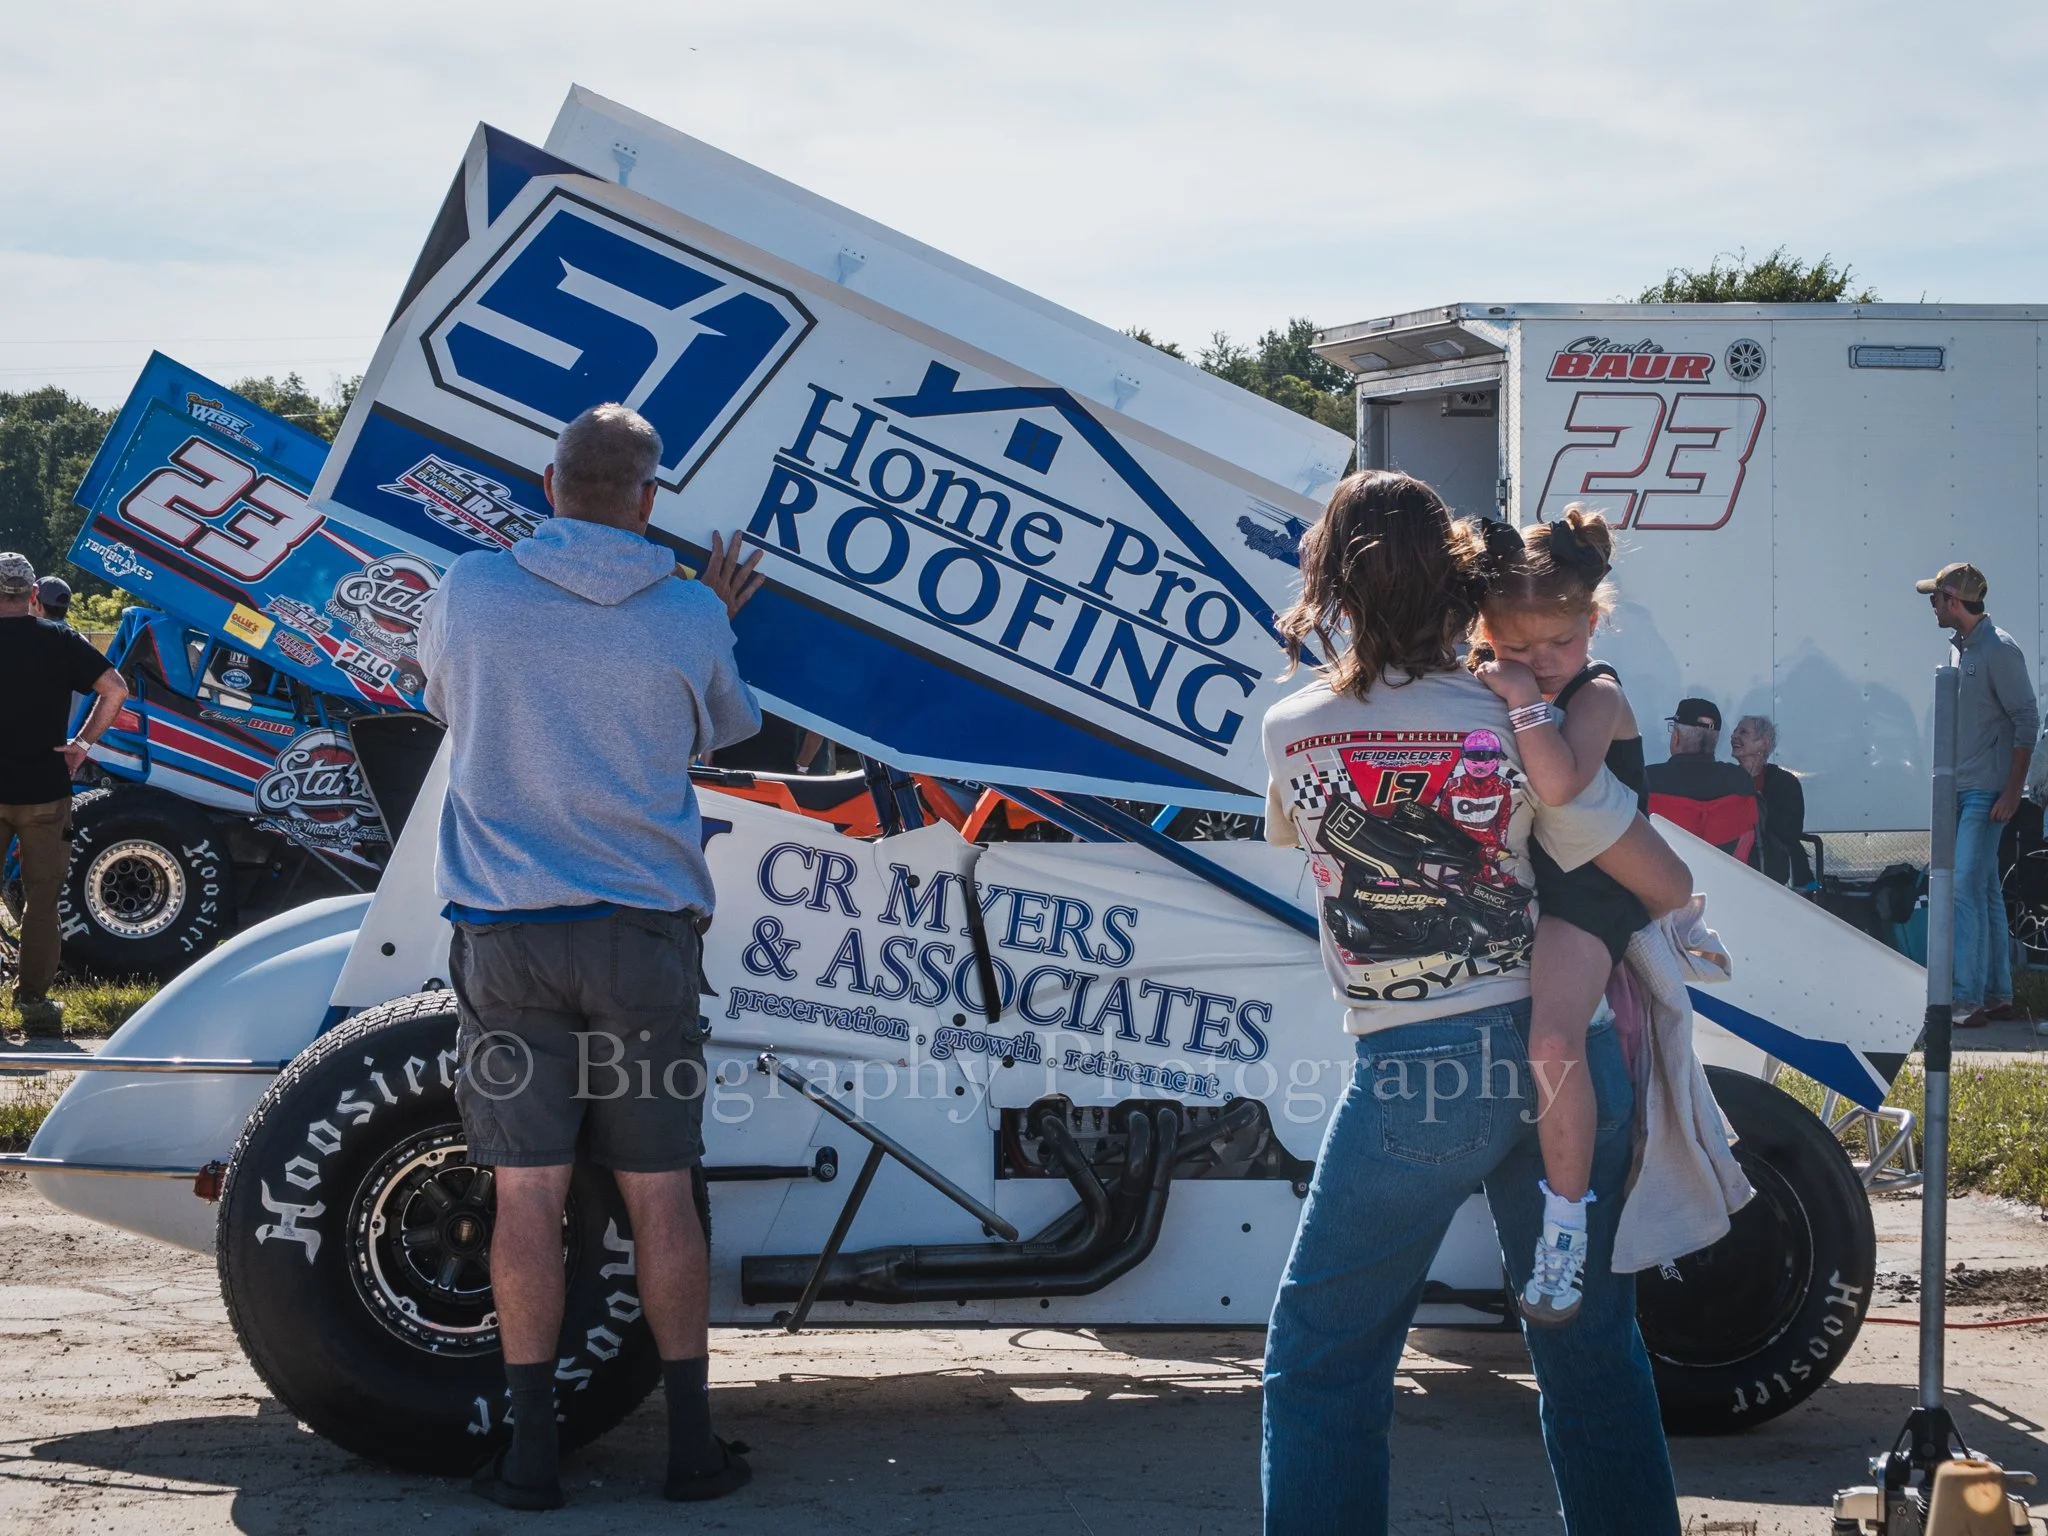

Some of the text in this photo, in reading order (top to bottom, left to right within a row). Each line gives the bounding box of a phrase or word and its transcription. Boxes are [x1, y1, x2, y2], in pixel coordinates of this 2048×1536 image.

[445, 208, 792, 471] 51
[1564, 336, 1665, 354] Charlie
[1546, 351, 1716, 384] BAUR
[190, 402, 249, 433] WISE
[1536, 391, 1767, 531] 23
[415, 471, 462, 503] BUMPER
[425, 464, 472, 495] BUMPER
[117, 434, 327, 584] 23
[417, 485, 505, 543] OUTLAW SPRINT SERIES
[462, 494, 509, 525] IRA
[779, 382, 1241, 647] Home Pro
[511, 521, 533, 537] Auto
[106, 549, 154, 581] BRAKES
[340, 563, 438, 630] Stah
[746, 464, 1257, 746] ROOFING
[231, 613, 259, 632] OLLIE'S
[325, 600, 361, 625] Motors
[366, 622, 395, 645] Music
[393, 637, 420, 661] Exper
[275, 637, 313, 667] BATTERIES
[278, 630, 321, 664] INTERSTATE
[346, 665, 374, 682] RACING
[353, 650, 393, 679] FLO
[200, 709, 247, 725] Charlie
[247, 718, 295, 737] BAUR
[1293, 732, 1459, 753] WRENCHIN TO WHEELIN
[1350, 750, 1452, 762] HEIDBREDER
[260, 750, 376, 818] Stah
[1373, 769, 1432, 807] 19
[303, 821, 338, 837] Music
[1325, 801, 1366, 841] 19
[181, 840, 220, 951] Hoosier
[757, 841, 861, 918] CR
[877, 862, 1138, 968] MYERS
[1353, 889, 1447, 907] HEIDBREDER
[1473, 888, 1506, 905] BRANCH
[741, 915, 1273, 1064] & ASSOCIATES
[727, 986, 1218, 1098] preservation growth retirement
[255, 1047, 459, 1265] Hoosier
[1732, 1269, 1863, 1413] Hoosier
